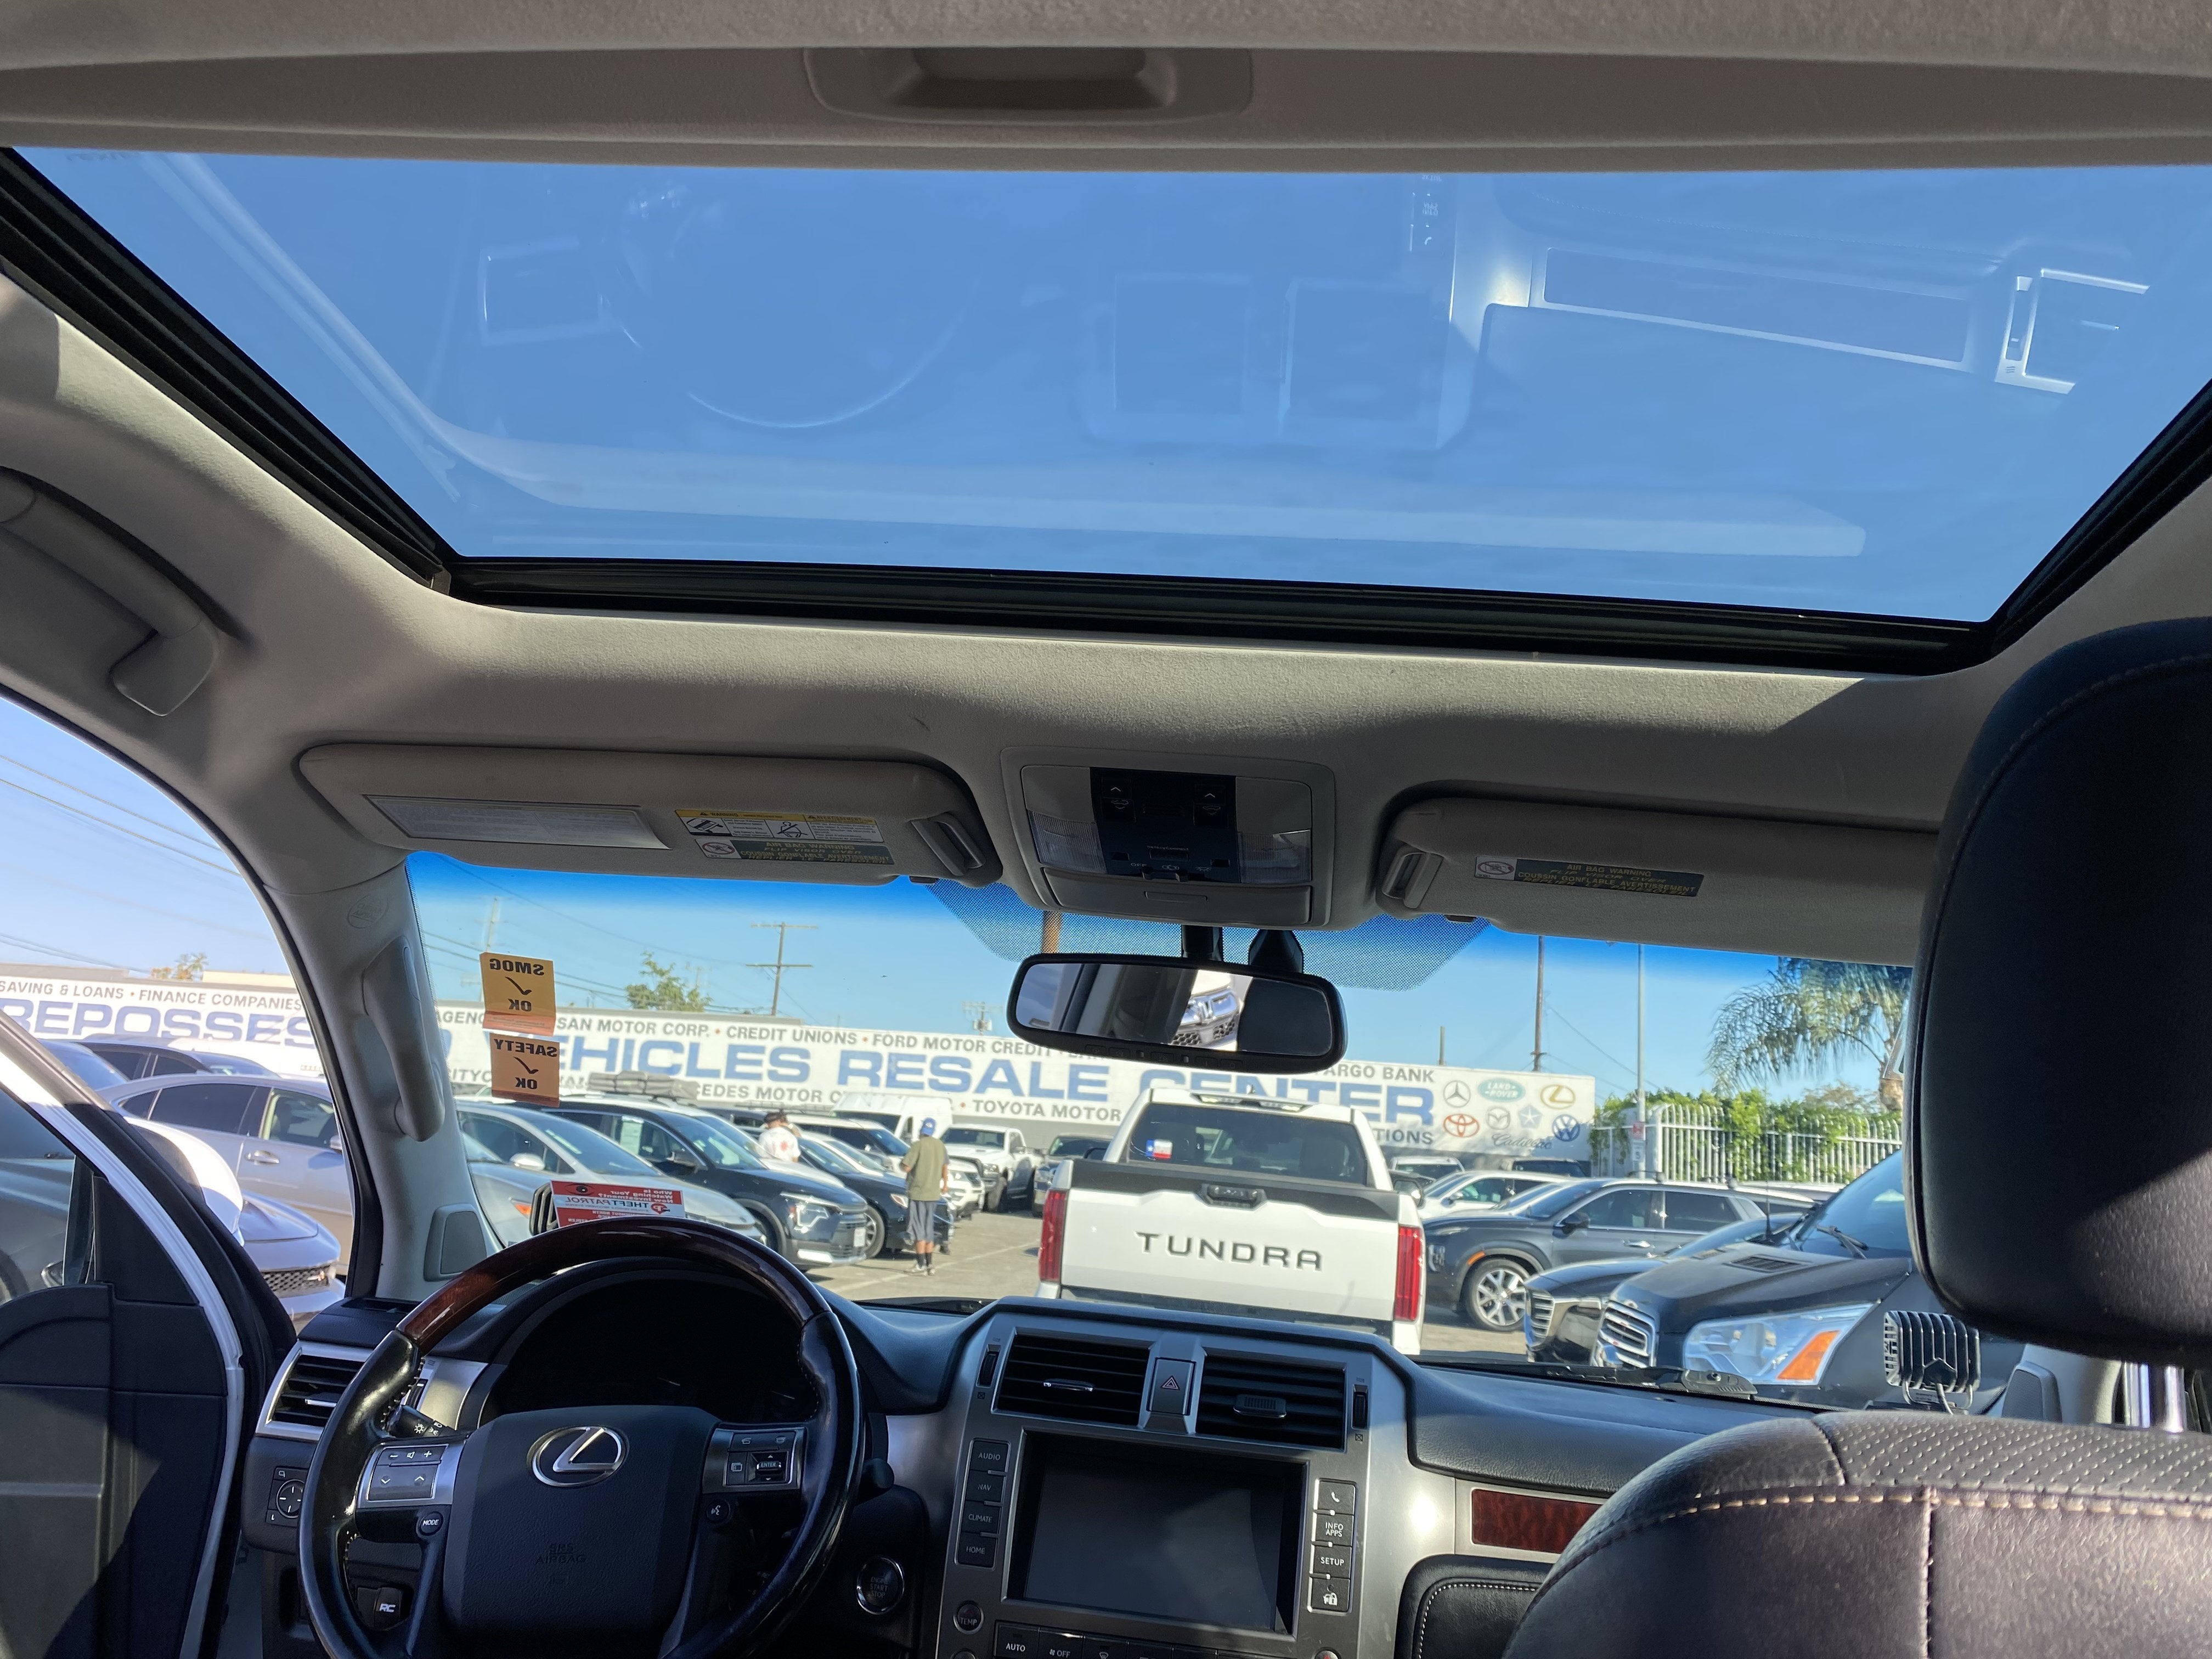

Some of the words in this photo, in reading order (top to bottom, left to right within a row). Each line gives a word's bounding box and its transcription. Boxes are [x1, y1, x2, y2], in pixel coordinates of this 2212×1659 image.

[1610, 867, 1652, 877] WARNING
[1518, 872, 1557, 880] COUSSIN
[1620, 881, 1696, 893] AVERTISSEMENT
[0, 980, 53, 995] SAVING
[60, 985, 69, 996] &
[73, 985, 124, 998] LOANS
[139, 989, 207, 1005] FINANCE
[212, 994, 302, 1011] COMPANIES
[597, 1018, 656, 1035] MOTOR
[663, 1022, 710, 1037] CORP.
[726, 1025, 790, 1042] CREDIT
[793, 1028, 857, 1045] UNIONS
[872, 1034, 917, 1048] FORD
[923, 1036, 986, 1053] MOTOR
[1318, 1063, 1375, 1079] ARGO
[1383, 1066, 1435, 1083] BANK
[488, 1030, 811, 1083] HICLES
[837, 1049, 1110, 1102] RESALE
[1487, 1082, 1511, 1090] LAND
[1489, 1090, 1519, 1098] ROVER
[698, 1083, 749, 1099] EDES
[757, 1085, 822, 1103] MOTOR
[973, 1099, 1046, 1117] TOYOTA
[1051, 1104, 1122, 1122] MOTOR
[1492, 1133, 1552, 1150] Cadillac
[1135, 1231, 1322, 1271] TUNDRA
[978, 1452, 1001, 1461] AUDIO
[968, 1513, 993, 1524] CLIMATE
[1325, 1522, 1344, 1531] INFO
[1325, 1529, 1343, 1537] APPS
[966, 1546, 986, 1555] HOME
[1321, 1556, 1345, 1566] SETUP
[870, 1583, 889, 1592] START
[961, 1617, 977, 1627] TEMP
[1006, 1642, 1026, 1652] AUTO
[1057, 1649, 1071, 1658] OFF
